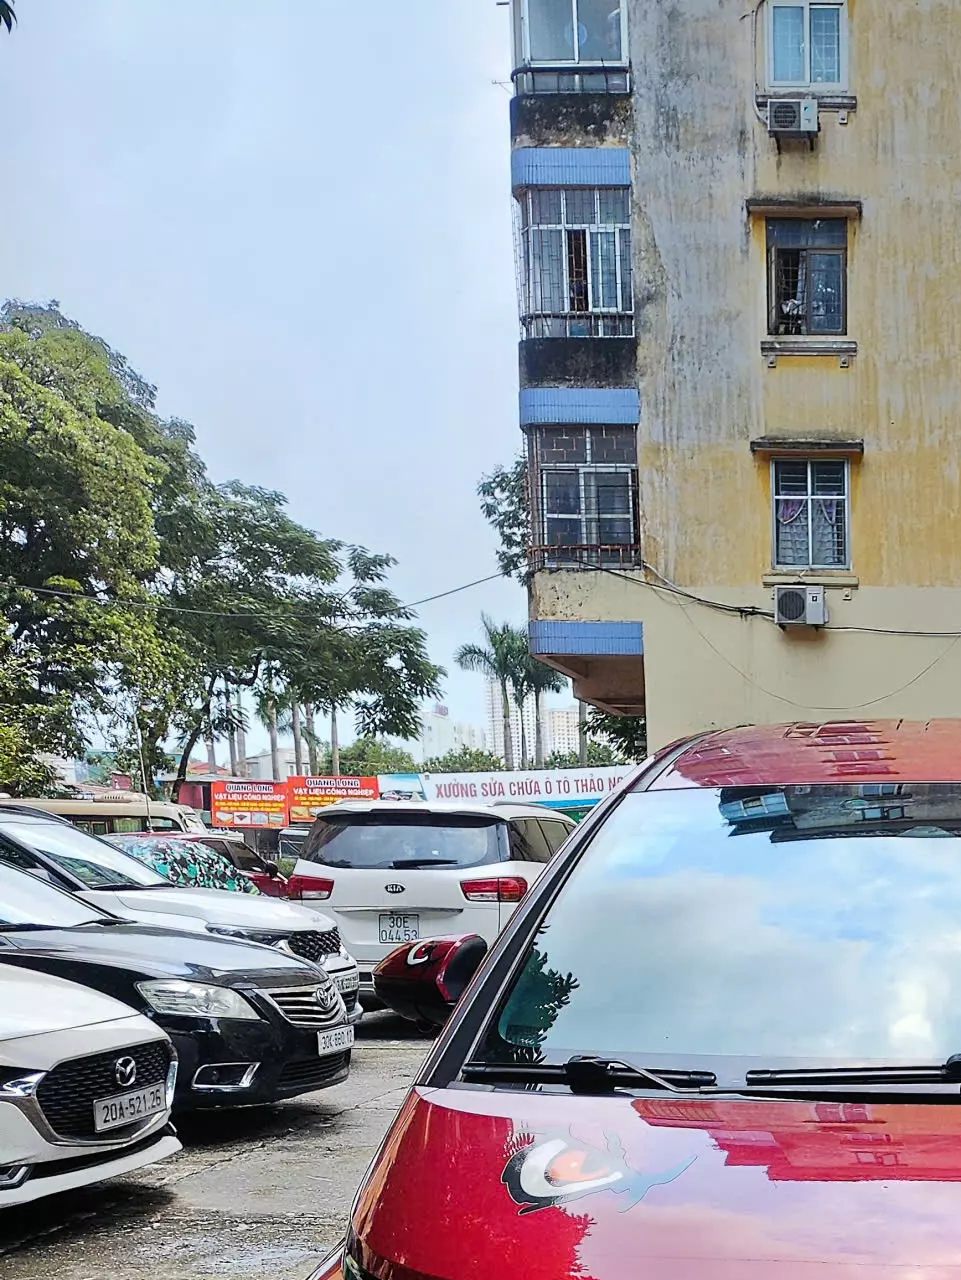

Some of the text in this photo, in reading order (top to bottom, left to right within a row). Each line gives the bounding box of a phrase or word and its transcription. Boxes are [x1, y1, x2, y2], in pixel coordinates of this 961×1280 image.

[306, 779, 360, 787] QUANG LONG
[435, 779, 477, 798] XƯỞNG
[481, 777, 505, 796] SỬA
[509, 777, 541, 796] CHỮA
[545, 777, 552, 795] Ô
[556, 777, 570, 794] TÔ
[574, 773, 604, 793] THẢO
[226, 784, 274, 793] QUANG LONG
[326, 788, 347, 796] CÔNG
[243, 793, 262, 801] CÔNG
[387, 884, 402, 892] KIA
[389, 916, 410, 929] 30E
[102, 1088, 162, 1124] 20A-521.26
